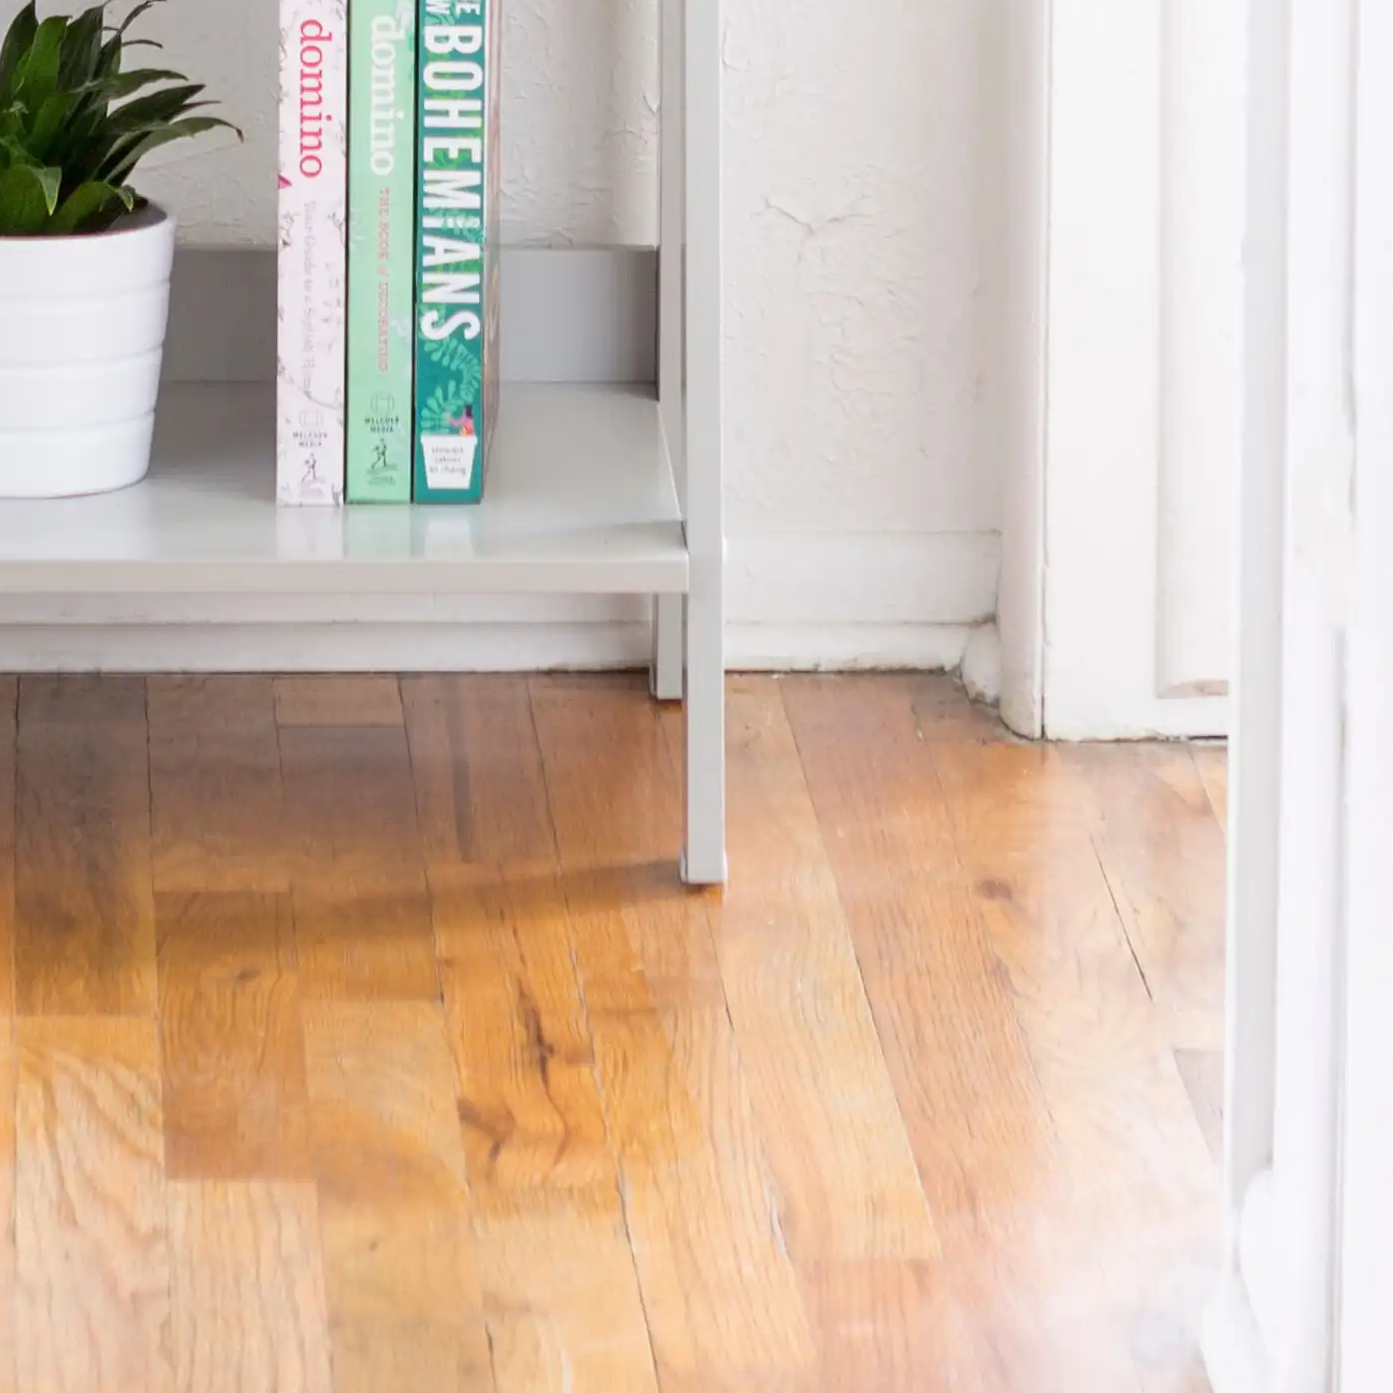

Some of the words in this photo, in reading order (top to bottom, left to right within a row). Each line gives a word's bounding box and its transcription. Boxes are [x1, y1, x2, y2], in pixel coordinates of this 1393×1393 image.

[299, 18, 333, 178] domino
[370, 15, 404, 176] domino
[421, 25, 483, 340] BOHEMIANS
